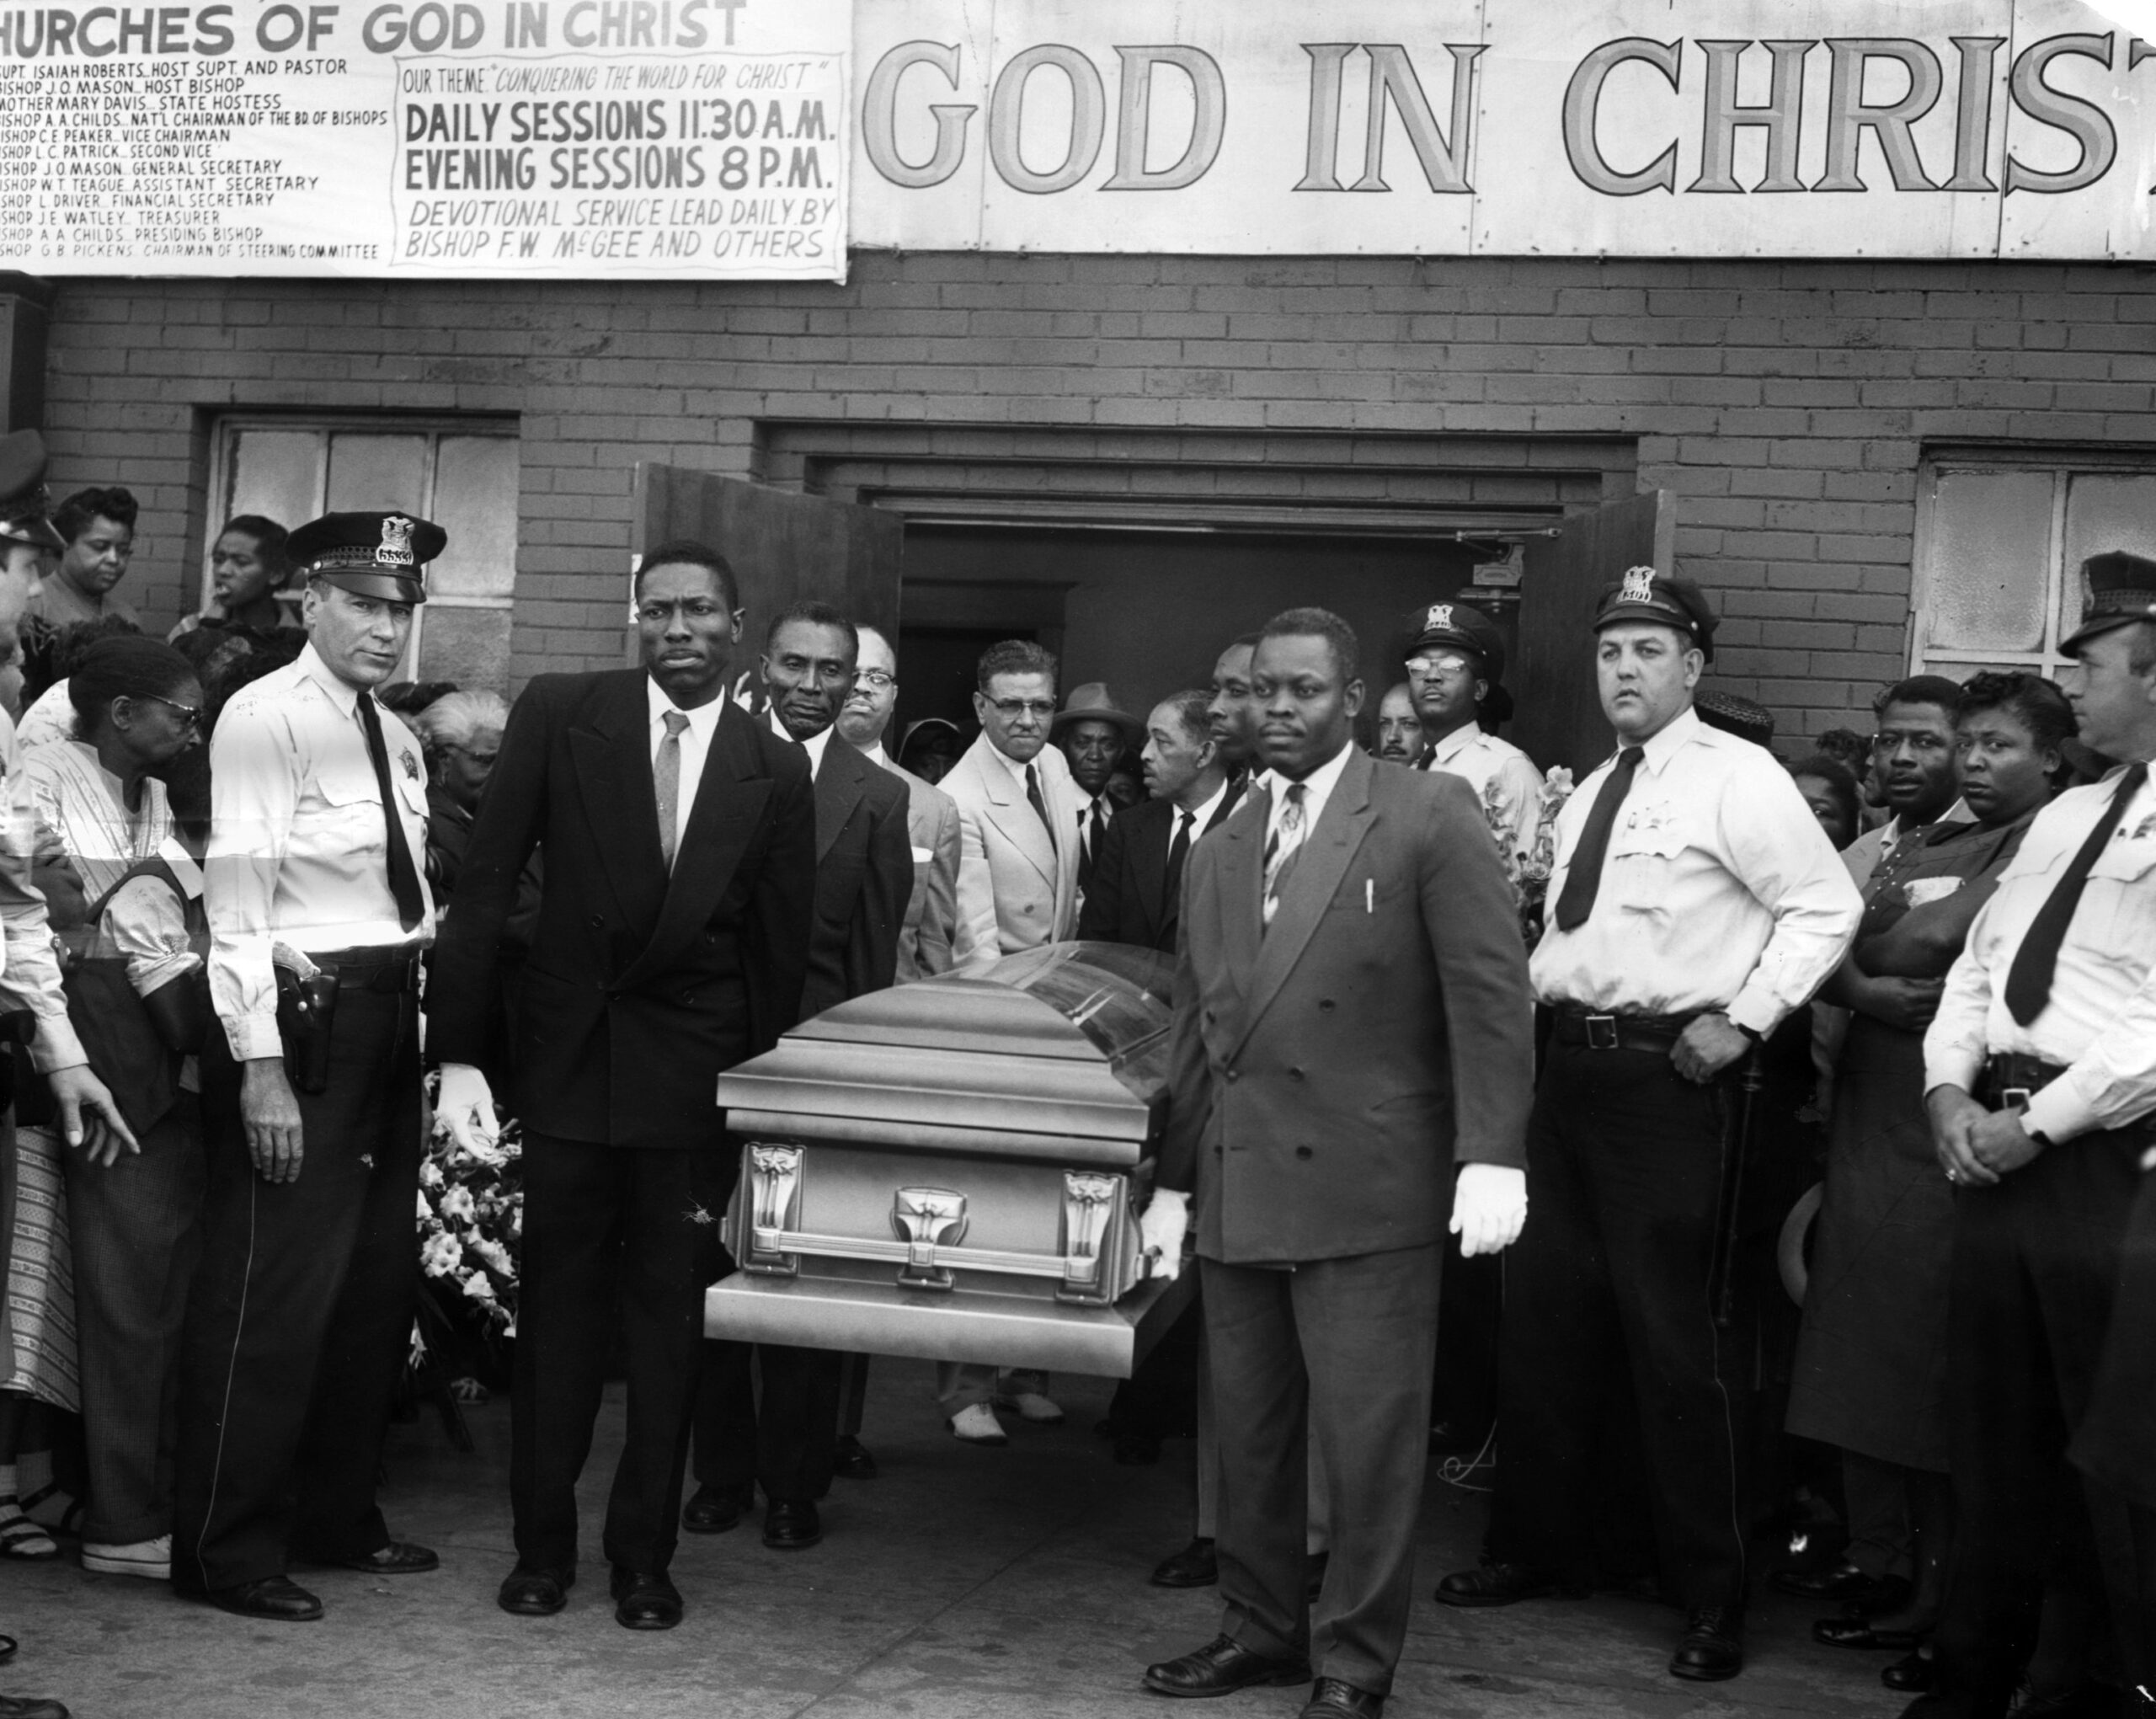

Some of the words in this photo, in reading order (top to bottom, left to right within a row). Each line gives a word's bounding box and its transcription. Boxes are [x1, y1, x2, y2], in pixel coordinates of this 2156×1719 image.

[256, 3, 339, 53] OF
[361, 2, 487, 56] GOD
[504, 2, 548, 49] IN
[562, 0, 747, 49] CHRIST
[0, 65, 26, 79] UPT.
[34, 65, 79, 80] ISAIAH
[83, 62, 144, 78] ROBERTS
[152, 61, 190, 77] HOST
[244, 60, 278, 75] AND
[285, 59, 347, 75] PASTOR
[403, 68, 432, 93] OUR
[605, 66, 635, 90] THE
[638, 65, 689, 89] WORLD
[692, 63, 727, 89] FOR
[76, 80, 135, 94] MASON
[145, 78, 184, 94] HOST
[189, 77, 244, 94] BISHOP
[56, 96, 99, 110] MARY
[104, 95, 147, 111] DAVIS
[159, 95, 206, 111] STATE
[213, 93, 281, 110] HOSTESS
[0, 113, 41, 128] ISHOP
[72, 112, 122, 127] CHILDS
[173, 112, 245, 127] CHAIRMAN
[248, 111, 264, 126] OF
[270, 111, 291, 125] THE
[312, 111, 328, 125] OF
[332, 110, 387, 125] BISHOPS
[406, 103, 502, 142] DAILY
[510, 99, 667, 143] SESSIONS
[761, 99, 837, 141] A.M.
[861, 38, 1228, 195] GOD
[1290, 40, 1492, 195] IN
[1561, 30, 2156, 198] CHRIS
[64, 129, 112, 143] PEAKER
[122, 129, 151, 143] VICE
[155, 129, 230, 142] CHAIRMAN
[63, 144, 119, 158] PATRICK
[131, 144, 179, 158] SECOND
[183, 144, 211, 158] VICE
[70, 162, 122, 176] MASON
[132, 161, 195, 175] GENERAL
[200, 159, 282, 175] SECRETARY
[406, 147, 536, 191] EVENING
[550, 145, 706, 190] SESSIONS
[718, 146, 749, 191] 8
[759, 146, 833, 189] P.M.
[72, 178, 125, 193] TEAGUE
[132, 178, 216, 194] ASSISTANT
[227, 176, 318, 191] SECRETARY
[54, 194, 100, 208] DRIVER
[112, 194, 184, 208] FINANCIAL
[189, 193, 275, 208] SECRETARY
[64, 211, 126, 226] WATLEY
[138, 211, 220, 226] TREASURER
[409, 199, 562, 227] DEVOTIONAL
[572, 198, 664, 227] SERVICE
[669, 198, 723, 226] LEAD
[799, 198, 837, 226] BY
[72, 227, 125, 243] CHILDS
[136, 227, 206, 243] PRESIDING
[213, 227, 263, 242] BISHOP
[405, 230, 491, 258] BISHOP
[648, 230, 702, 258] AND
[712, 229, 824, 259] OTHERS
[73, 244, 133, 258] PICKENS
[144, 244, 213, 257] CHAIRMAN
[218, 243, 232, 258] OF
[239, 243, 296, 258] STEERING
[300, 244, 378, 259] COMMITTEE
